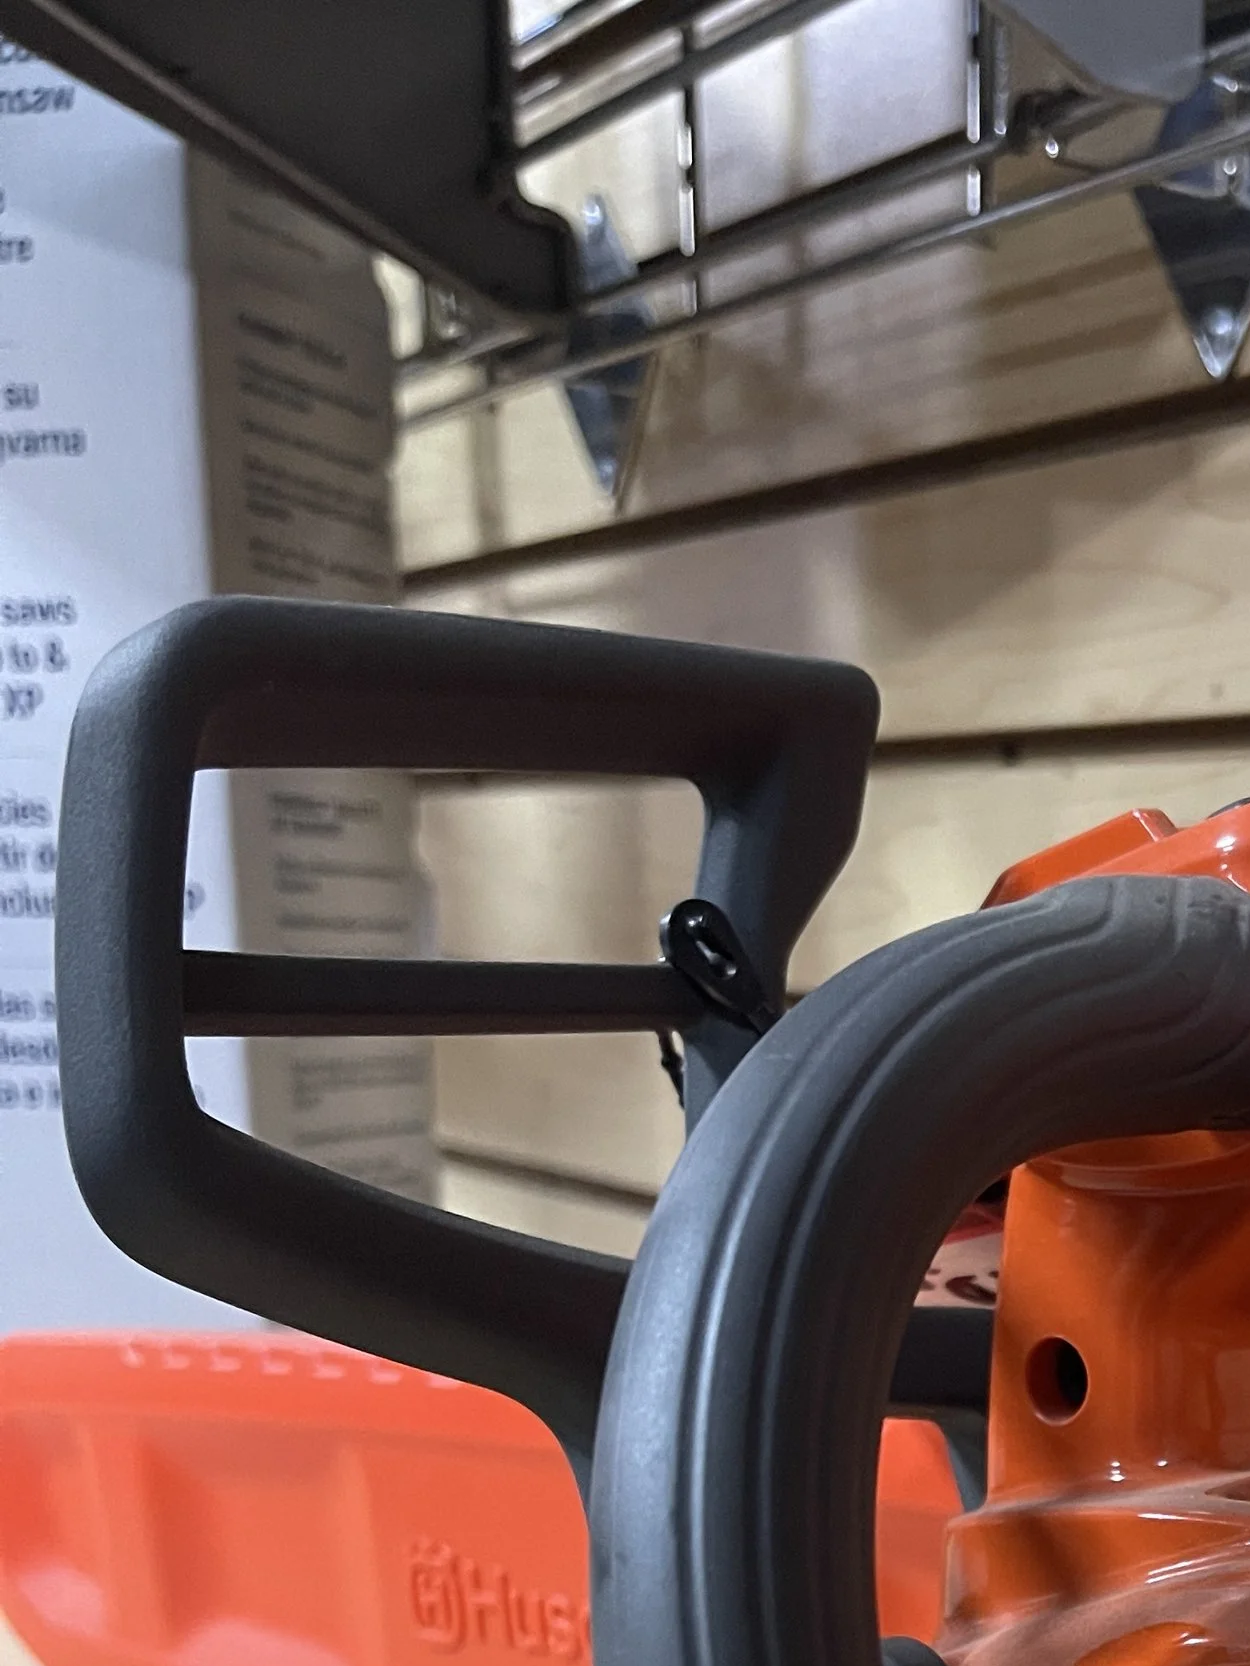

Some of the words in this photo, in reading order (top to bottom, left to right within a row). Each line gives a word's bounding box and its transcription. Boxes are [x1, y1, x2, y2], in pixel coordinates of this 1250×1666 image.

[0, 430, 87, 463] varna
[1, 597, 77, 627] saws
[468, 1556, 590, 1665] Hus
